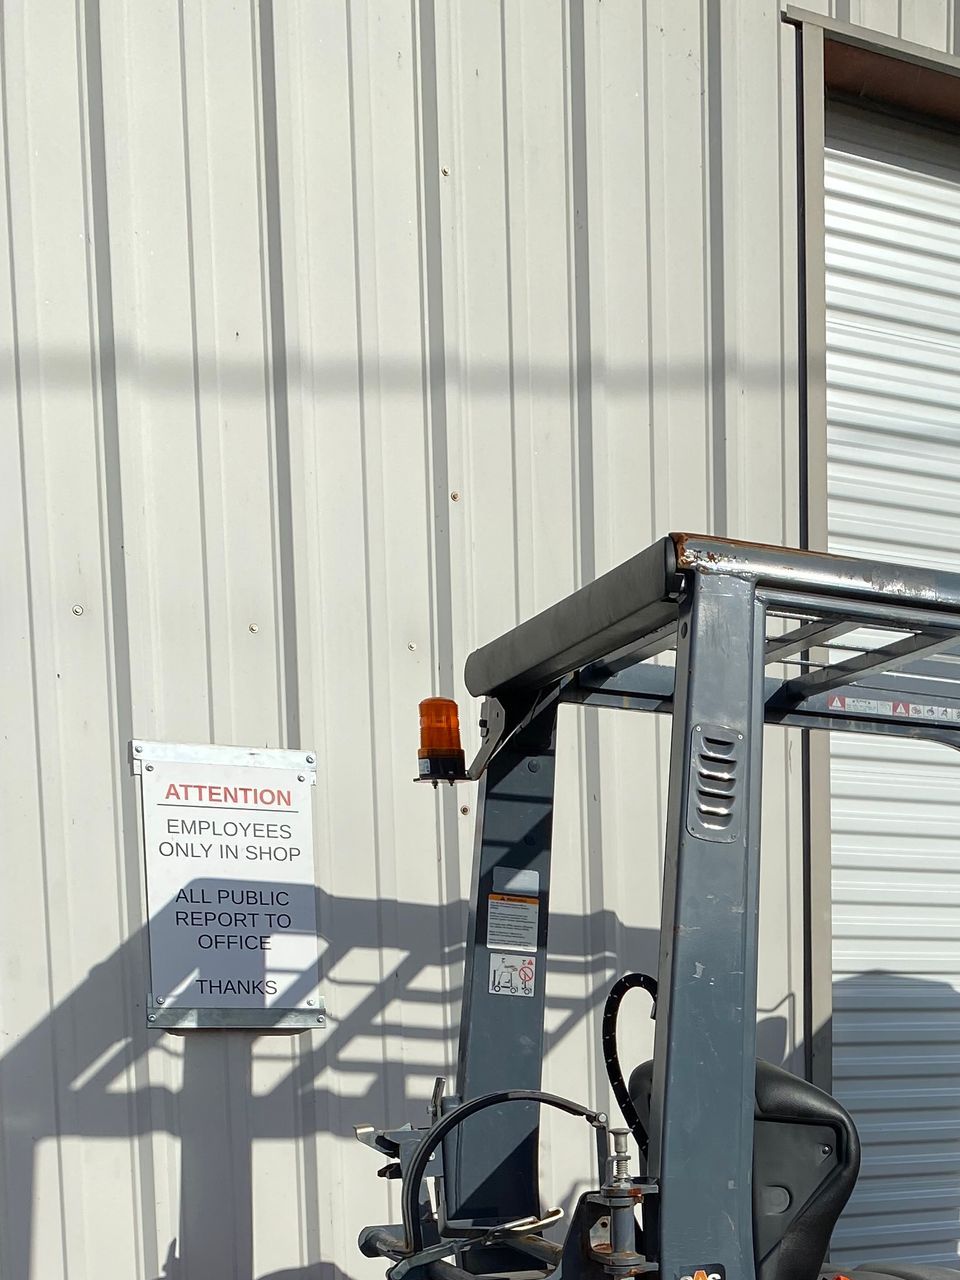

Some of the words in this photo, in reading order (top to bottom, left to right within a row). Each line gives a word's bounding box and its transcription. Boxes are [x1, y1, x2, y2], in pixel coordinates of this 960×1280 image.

[165, 783, 292, 807] ATTENTION
[166, 819, 292, 840] EMPLOYEES
[158, 841, 213, 859] ONLY
[219, 844, 239, 860] IN
[245, 845, 301, 862] SHOP
[175, 888, 212, 904] ALL
[217, 890, 290, 906] PUBLIC
[175, 911, 259, 928] REPORT
[265, 913, 292, 929] TO
[197, 934, 272, 951] OFFICE
[195, 979, 278, 996] THANKS
